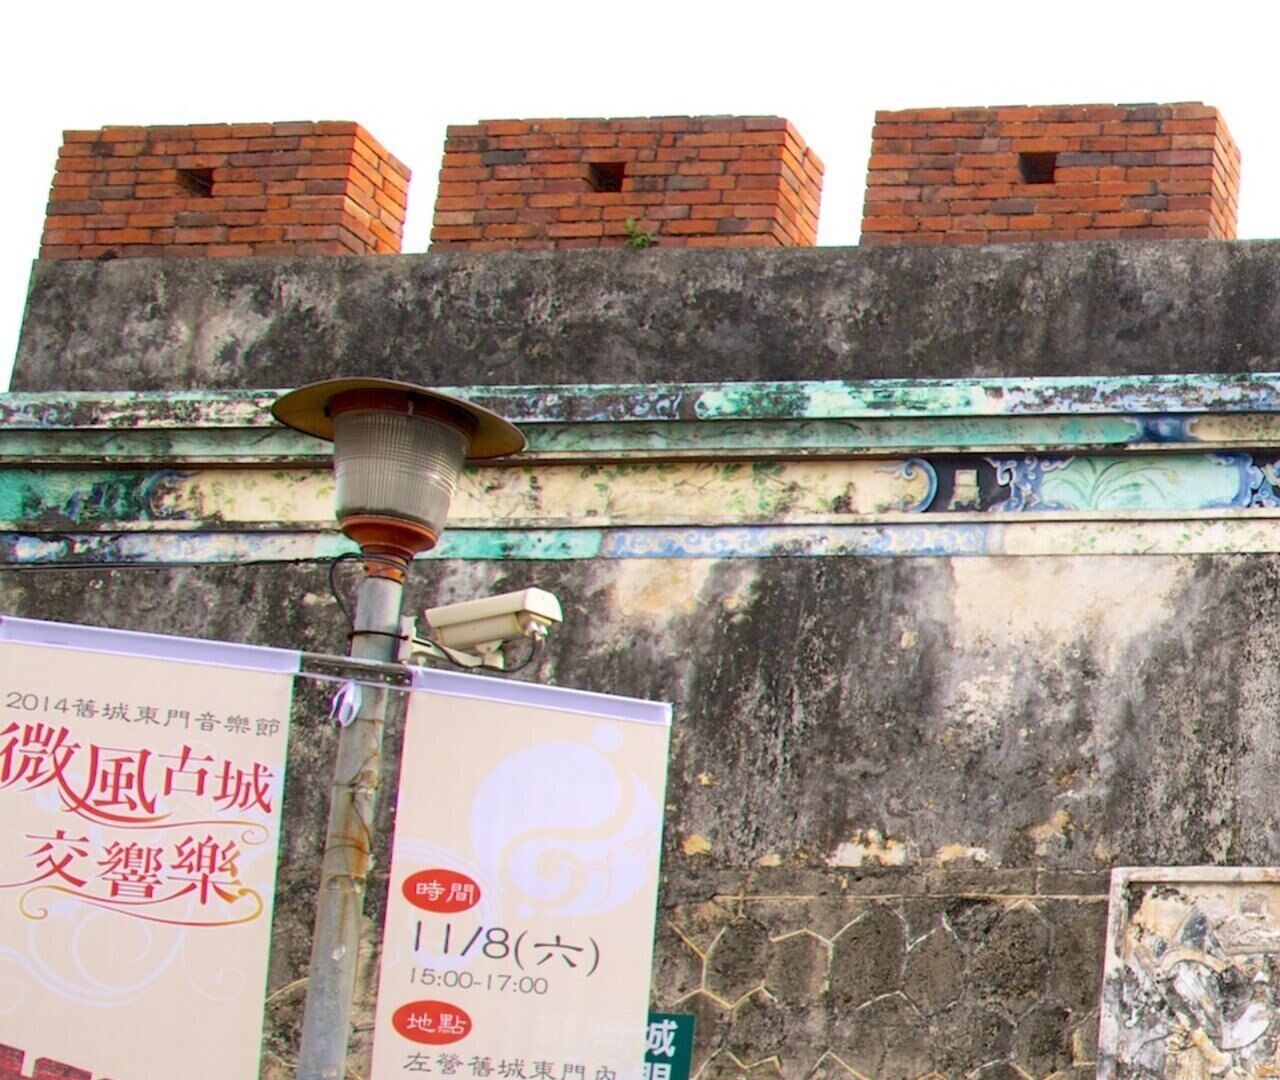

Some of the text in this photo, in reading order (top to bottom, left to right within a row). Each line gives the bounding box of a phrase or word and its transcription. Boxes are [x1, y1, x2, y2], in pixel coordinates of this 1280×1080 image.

[6, 691, 281, 738] 2014舊城東門音樂節
[0, 721, 276, 822] 微風古城
[23, 828, 243, 906] 交響樂
[415, 878, 476, 905] 時間
[409, 967, 549, 995] 15:00-17:00
[405, 1012, 468, 1036] 地點
